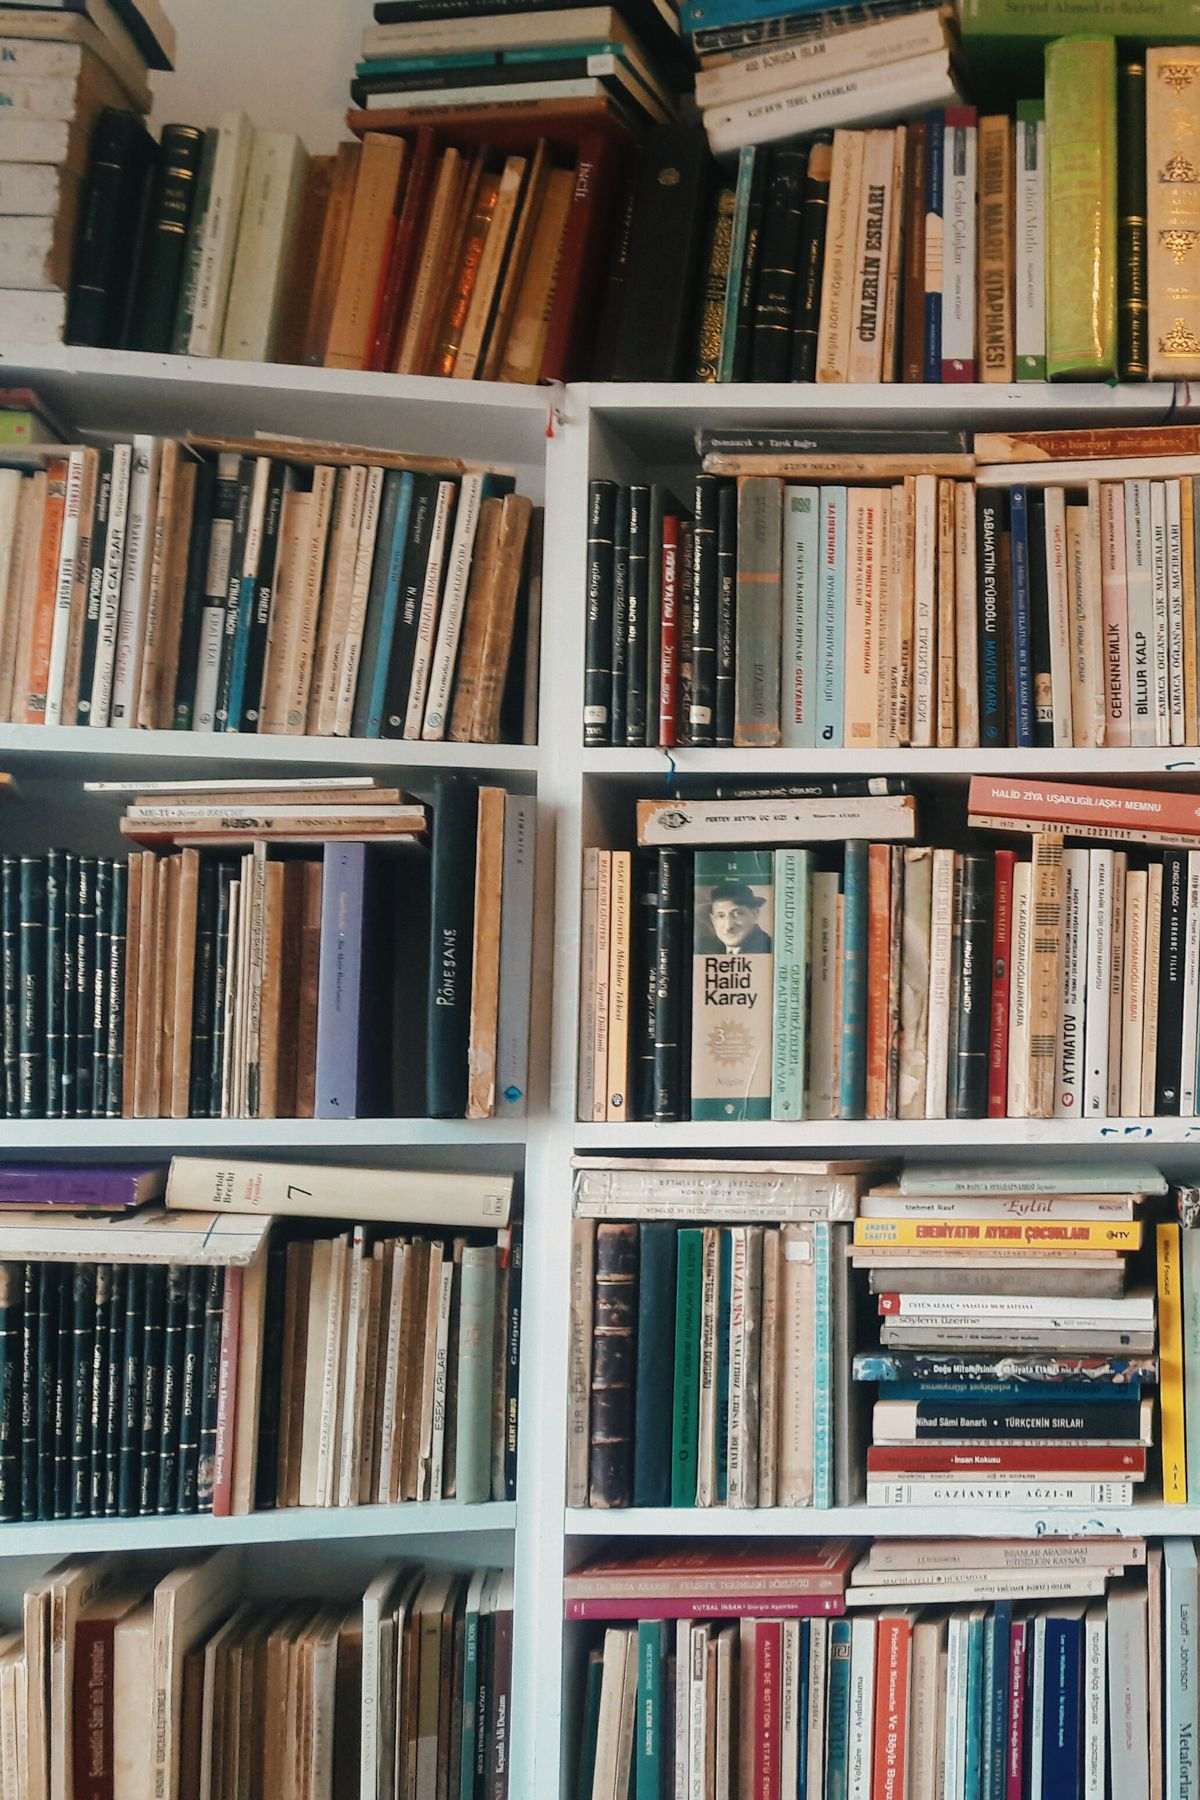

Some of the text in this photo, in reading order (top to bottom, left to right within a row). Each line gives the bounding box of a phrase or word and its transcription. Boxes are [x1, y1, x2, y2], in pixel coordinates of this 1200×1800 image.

[857, 184, 887, 344] CİNLERİN ESRARI
[107, 529, 122, 590] CAESAR
[984, 508, 996, 574] SABAHATTİN
[103, 594, 117, 647] JULIUS
[1108, 623, 1123, 719] CEHENNEMLİK
[1135, 631, 1149, 715] BİLLUR KALP
[1125, 799, 1161, 812] MEMNU
[705, 957, 752, 973] Refik
[705, 973, 750, 989] Halid
[704, 991, 758, 1009] Karay
[1063, 1014, 1077, 1085] AYTMATOV
[287, 1184, 313, 1201] 7
[854, 1748, 862, 1782] Voltaire
